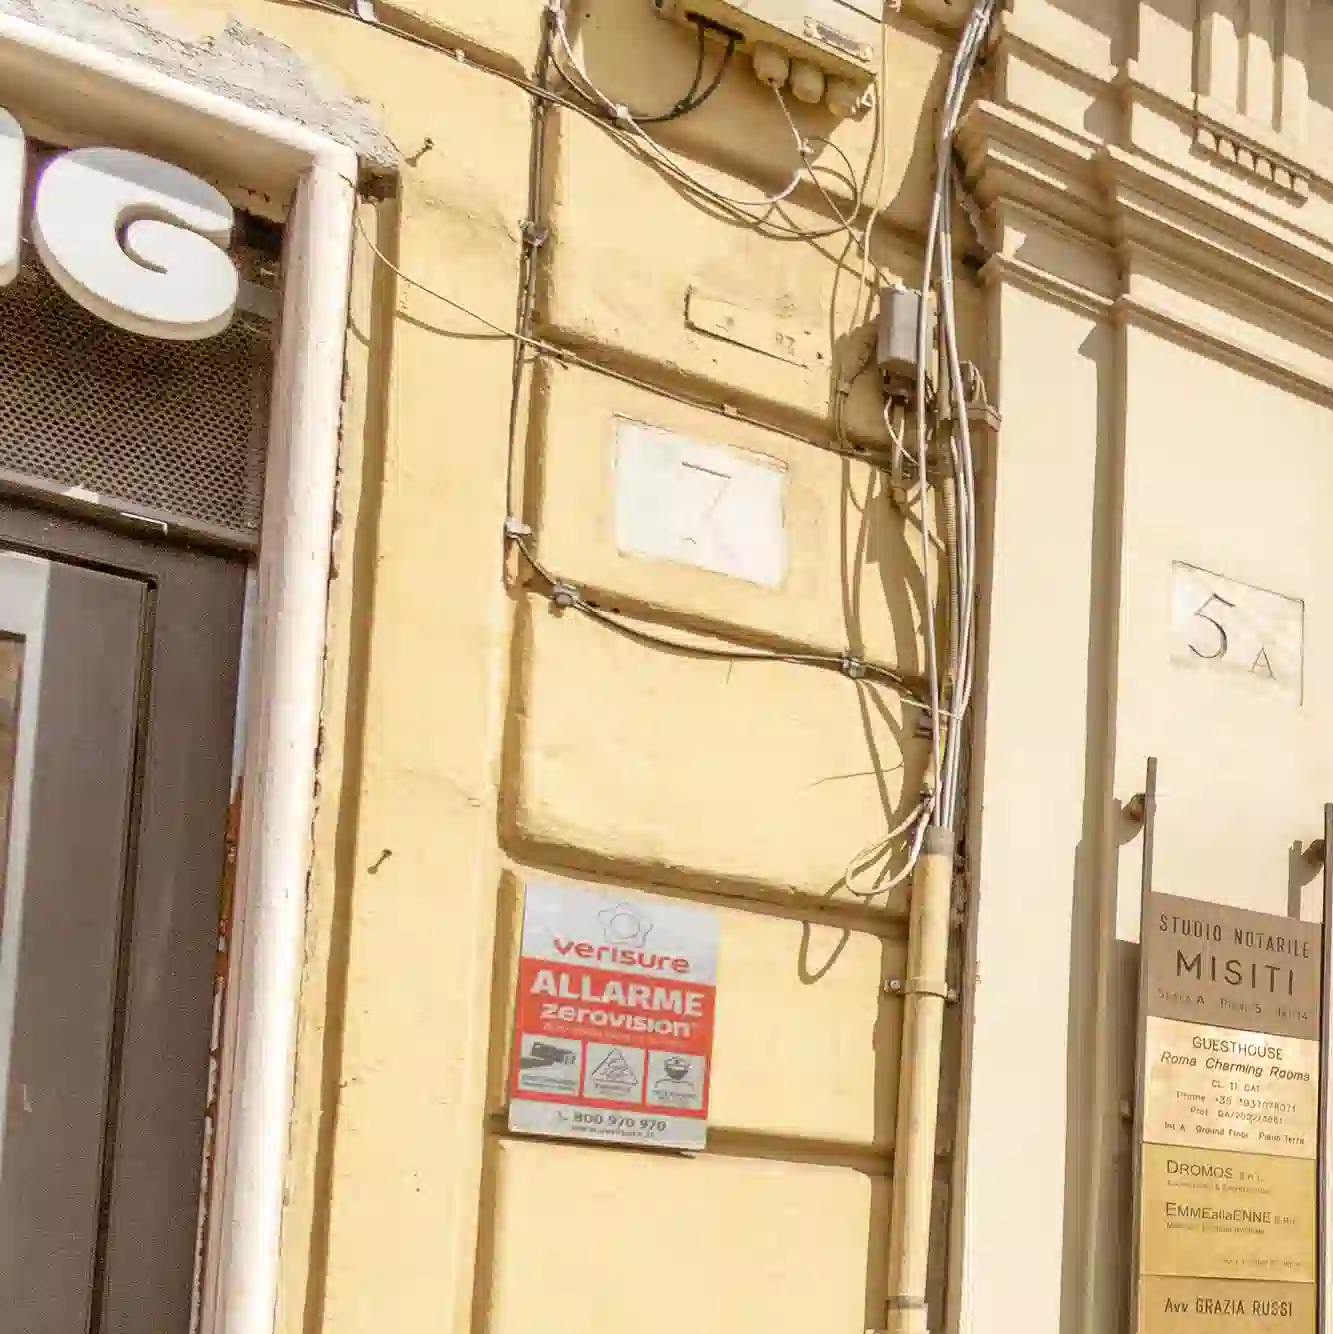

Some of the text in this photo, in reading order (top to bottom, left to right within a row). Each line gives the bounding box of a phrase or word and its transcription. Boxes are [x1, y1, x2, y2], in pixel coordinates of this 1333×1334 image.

[1159, 912, 1309, 959] STUDIO NOTARILE
[553, 937, 690, 973] verisure
[1176, 949, 1294, 996] MISITI
[530, 969, 705, 1017] ALLARME
[540, 1002, 691, 1037] zerovision
[1192, 1035, 1284, 1061] GUESTHOUSE
[1160, 1050, 1310, 1082] Roma Charming Rooms
[573, 1110, 603, 1125] 800
[1166, 1159, 1233, 1179] DROMOS
[1195, 1297, 1245, 1316] GRAZIA
[1252, 1300, 1293, 1317] RUSSI
